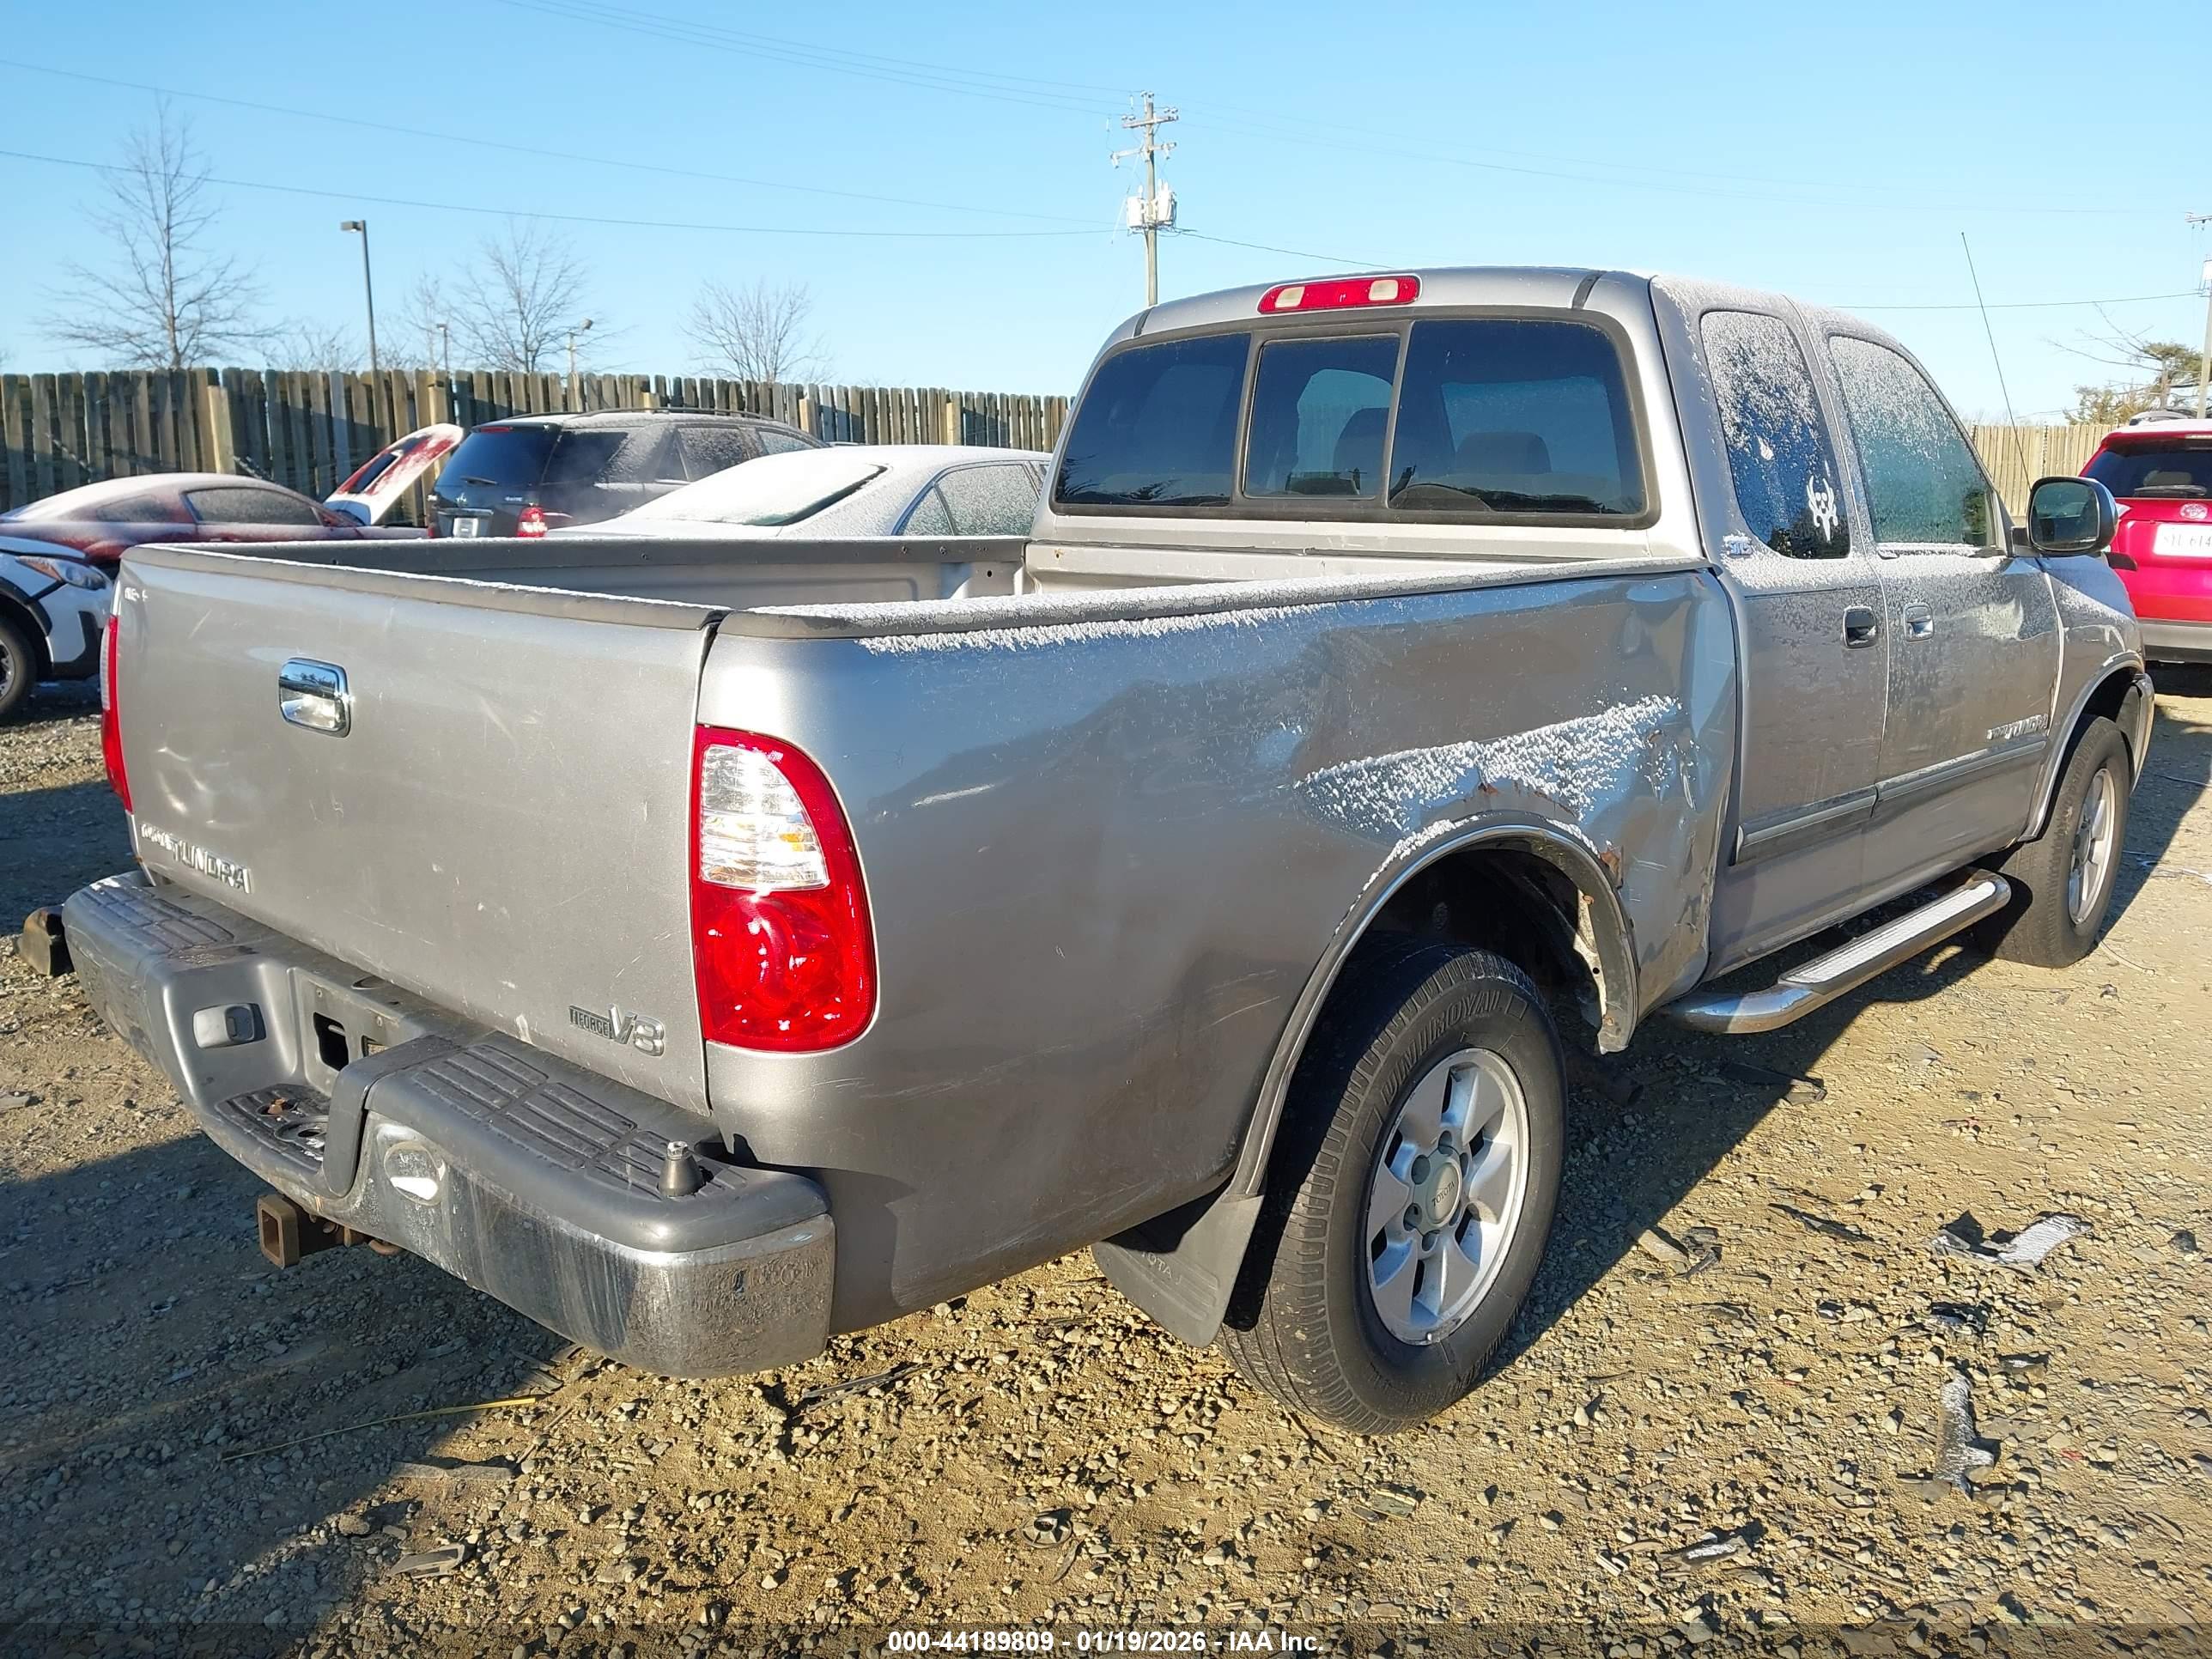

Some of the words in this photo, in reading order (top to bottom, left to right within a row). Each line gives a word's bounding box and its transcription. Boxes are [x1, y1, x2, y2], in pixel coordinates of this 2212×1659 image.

[173, 839, 252, 894] TUNDRA
[606, 1003, 665, 1057] V8
[1381, 989, 1503, 1107] UNIROYAL
[1431, 1181, 1455, 1207] TOYOTA
